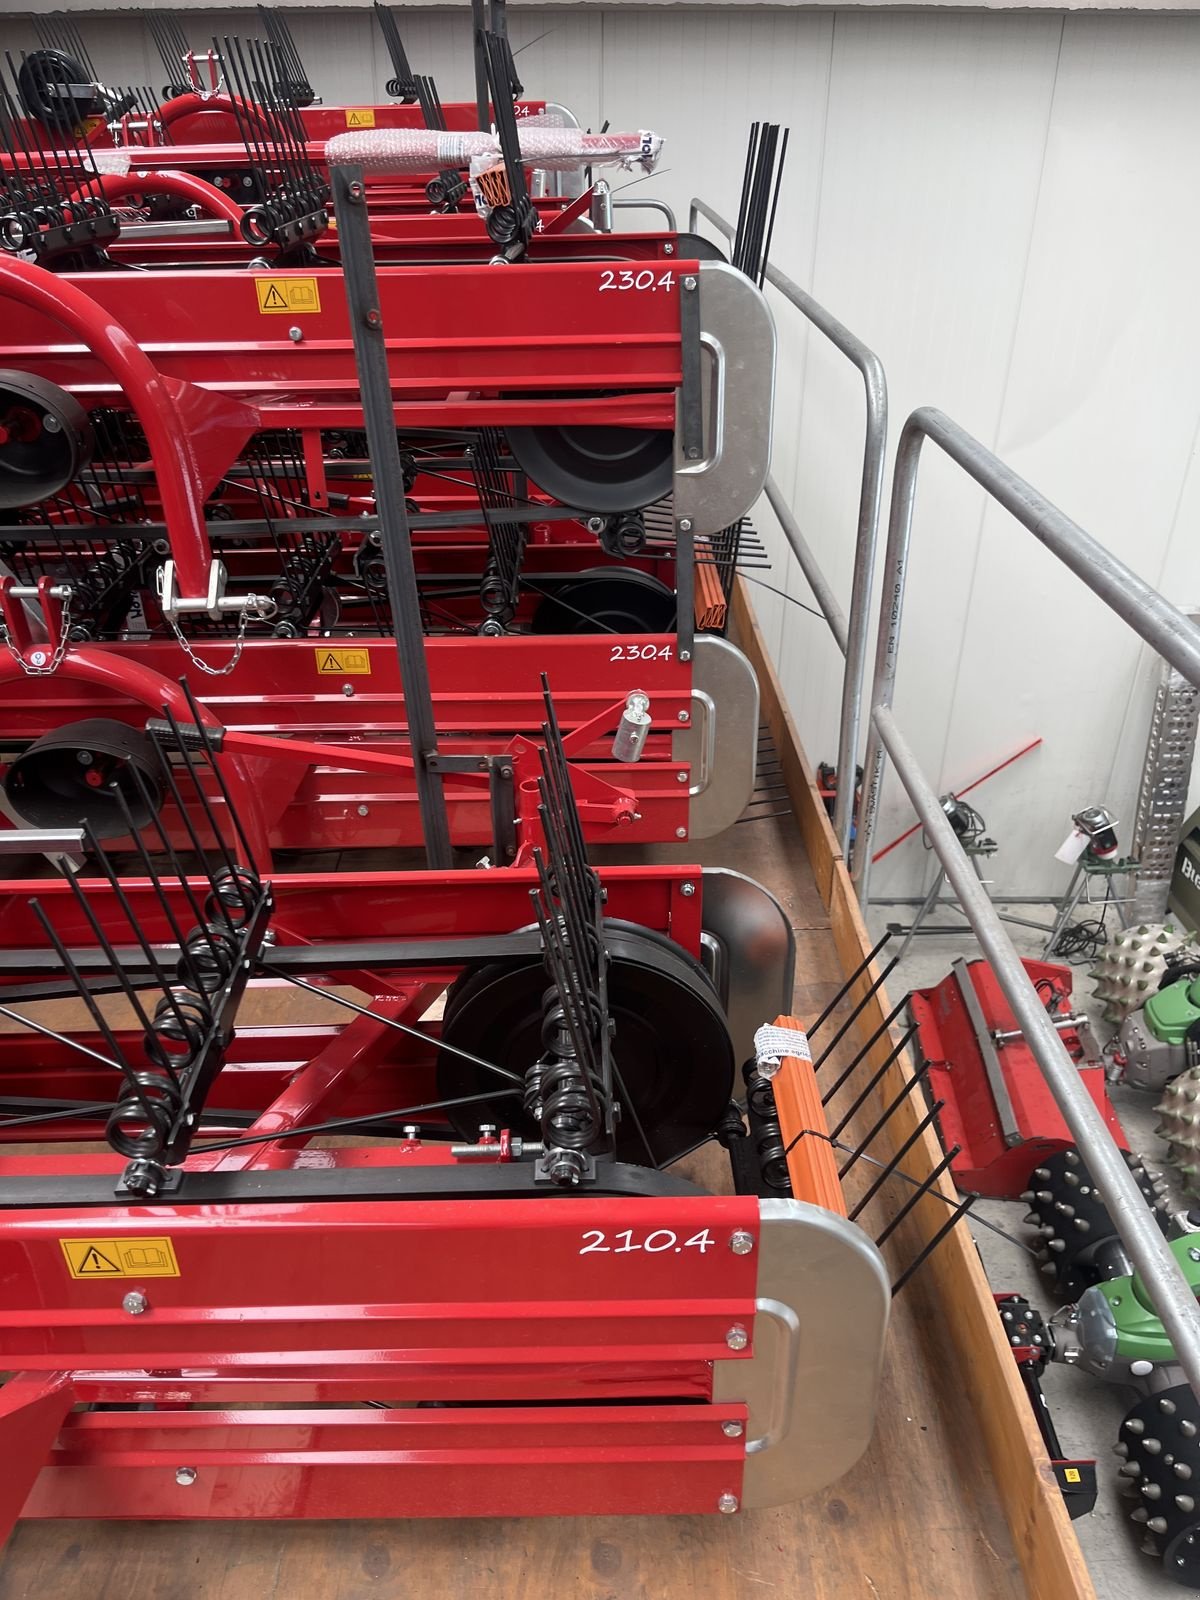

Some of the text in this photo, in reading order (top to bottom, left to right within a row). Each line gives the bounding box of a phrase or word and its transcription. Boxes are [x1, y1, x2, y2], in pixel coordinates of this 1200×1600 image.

[598, 269, 676, 292] 230.4
[609, 643, 673, 662] 230.4
[579, 1228, 716, 1255] 210.4
